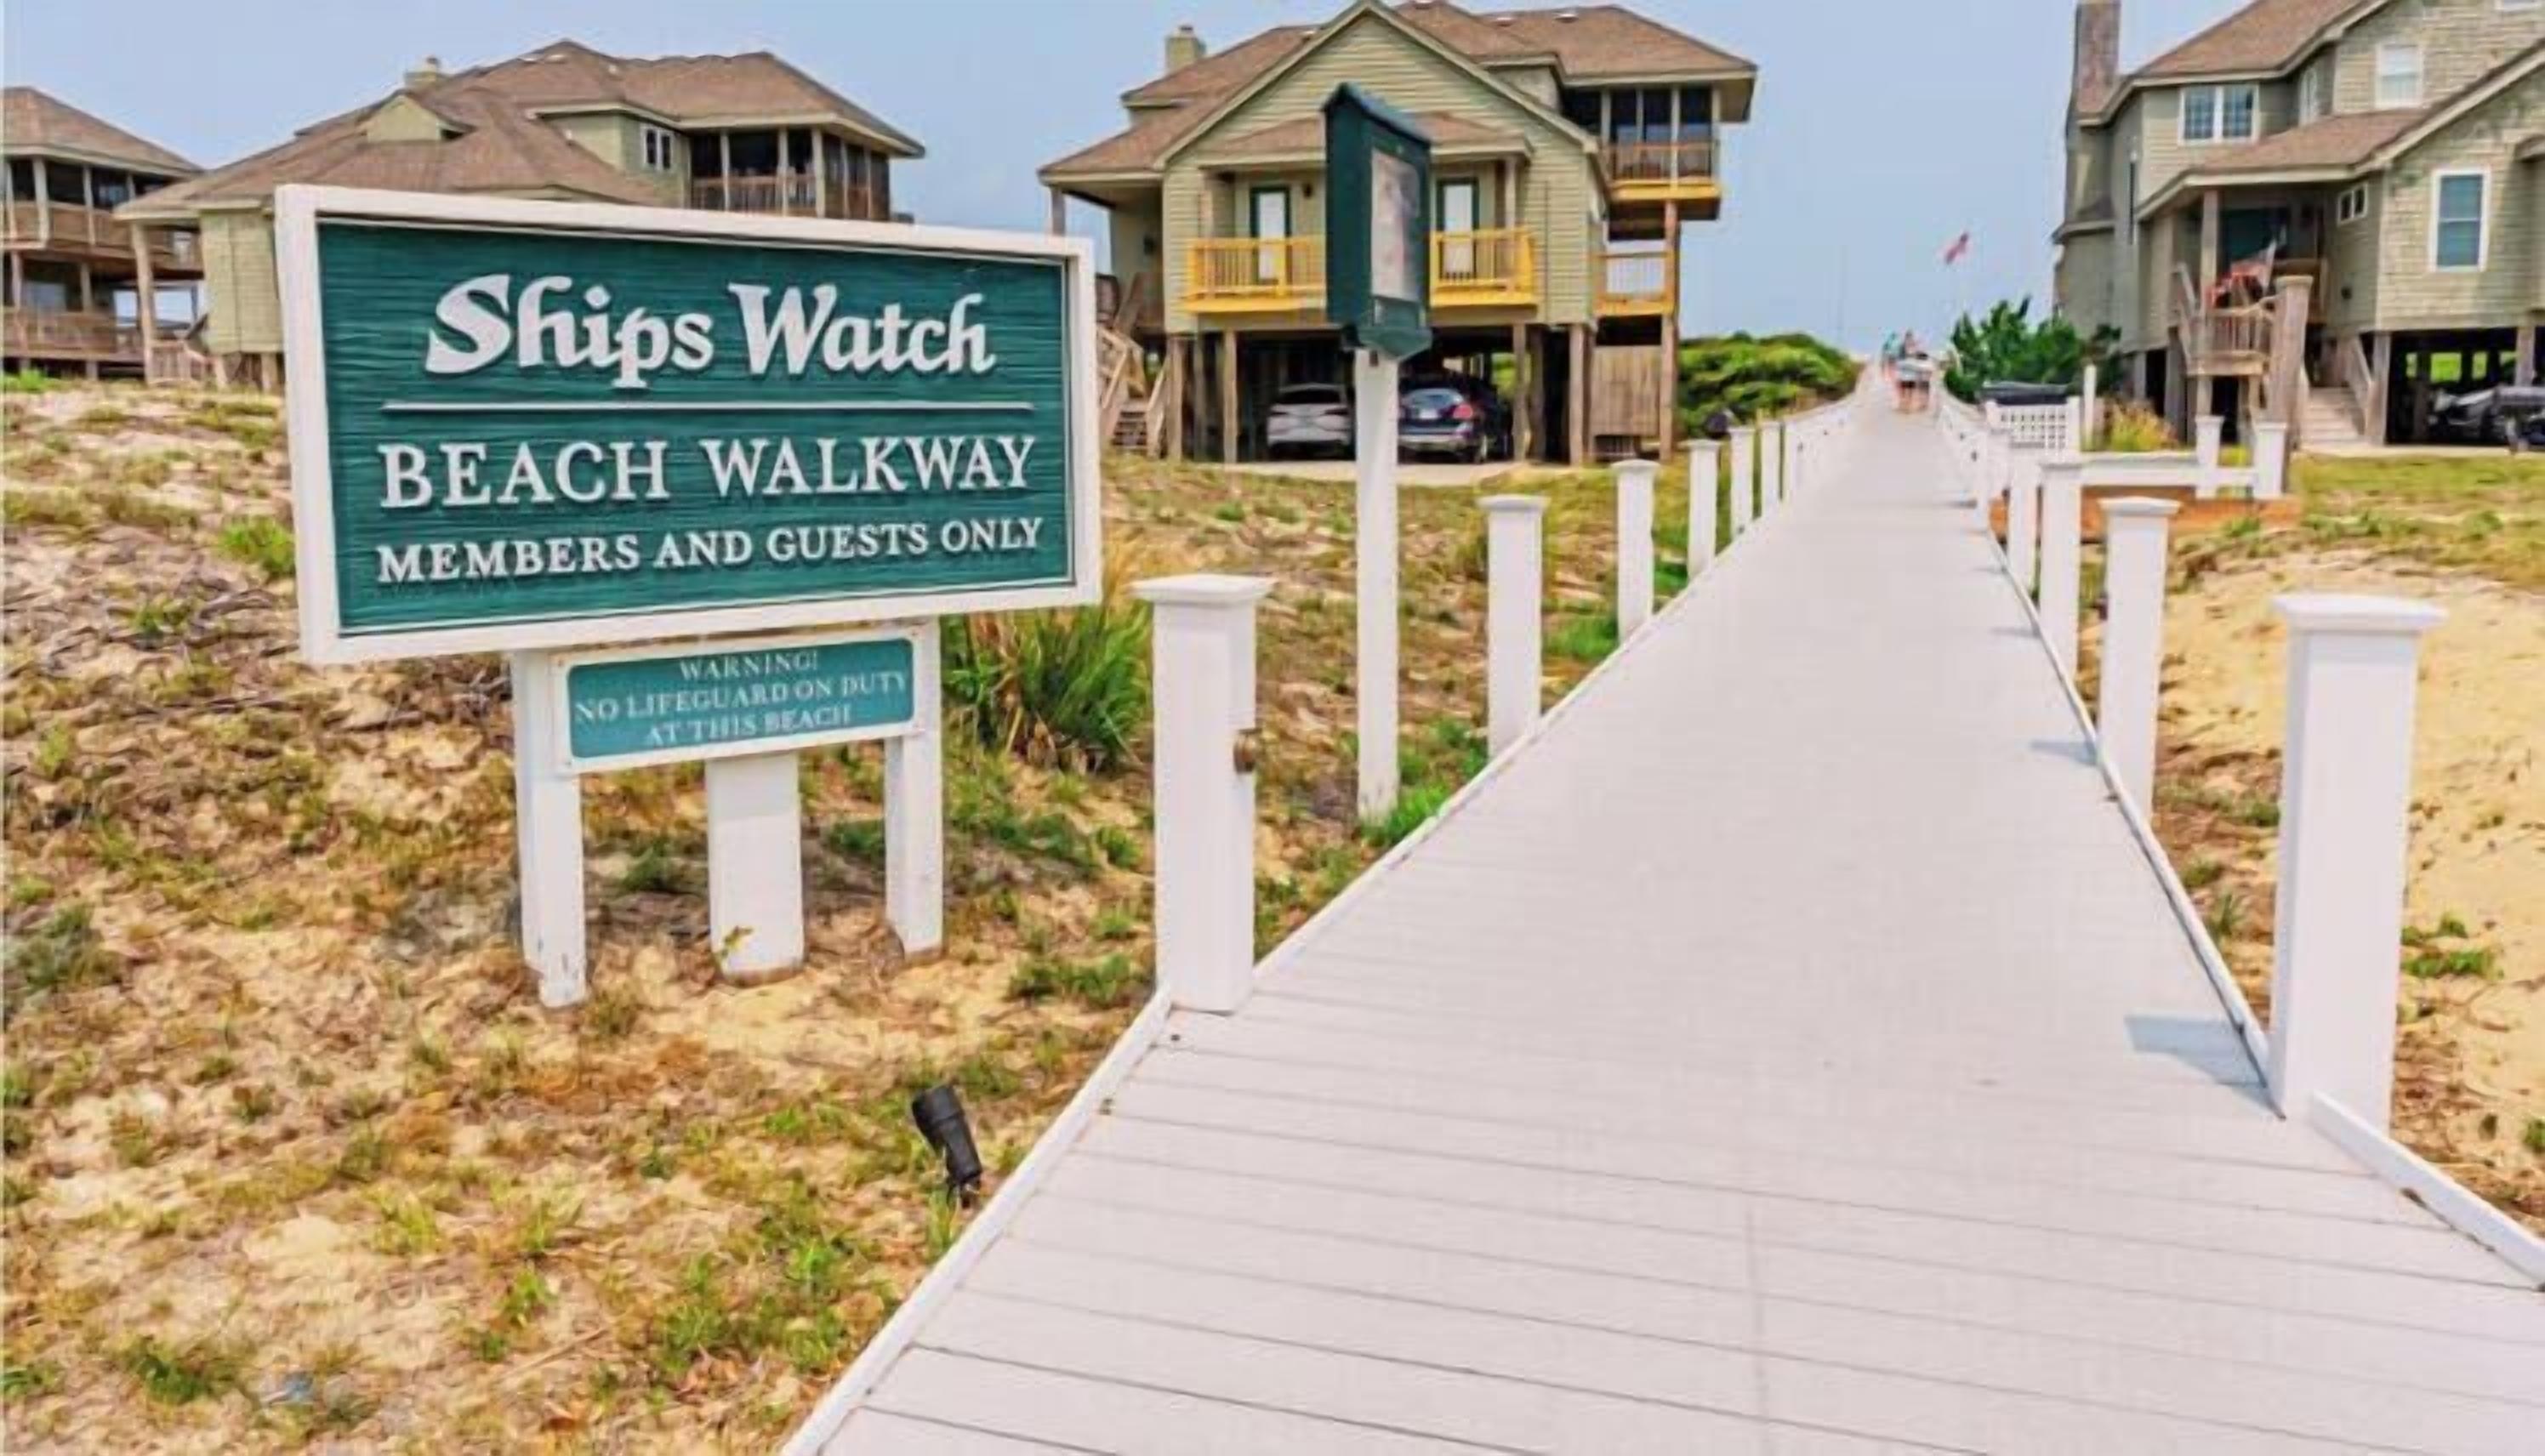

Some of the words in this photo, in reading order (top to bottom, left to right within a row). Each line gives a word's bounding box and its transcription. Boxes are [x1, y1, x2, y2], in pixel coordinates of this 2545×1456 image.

[425, 274, 714, 390] Ships
[728, 282, 996, 376] Watch
[379, 441, 669, 509] BEACH
[702, 435, 1035, 498] WALKWAY
[377, 534, 640, 583] MEMBERS
[654, 530, 752, 568] AND
[767, 522, 927, 560] GUESTS
[940, 516, 1043, 553] ONLY
[679, 650, 818, 681] WARNING!
[575, 698, 620, 724] NO
[626, 682, 789, 719] LIFEGUARD
[794, 678, 833, 701] ON
[840, 671, 907, 697] DUTY
[646, 721, 680, 746] AT
[686, 714, 757, 742] THIS
[764, 704, 851, 734] BEACH
